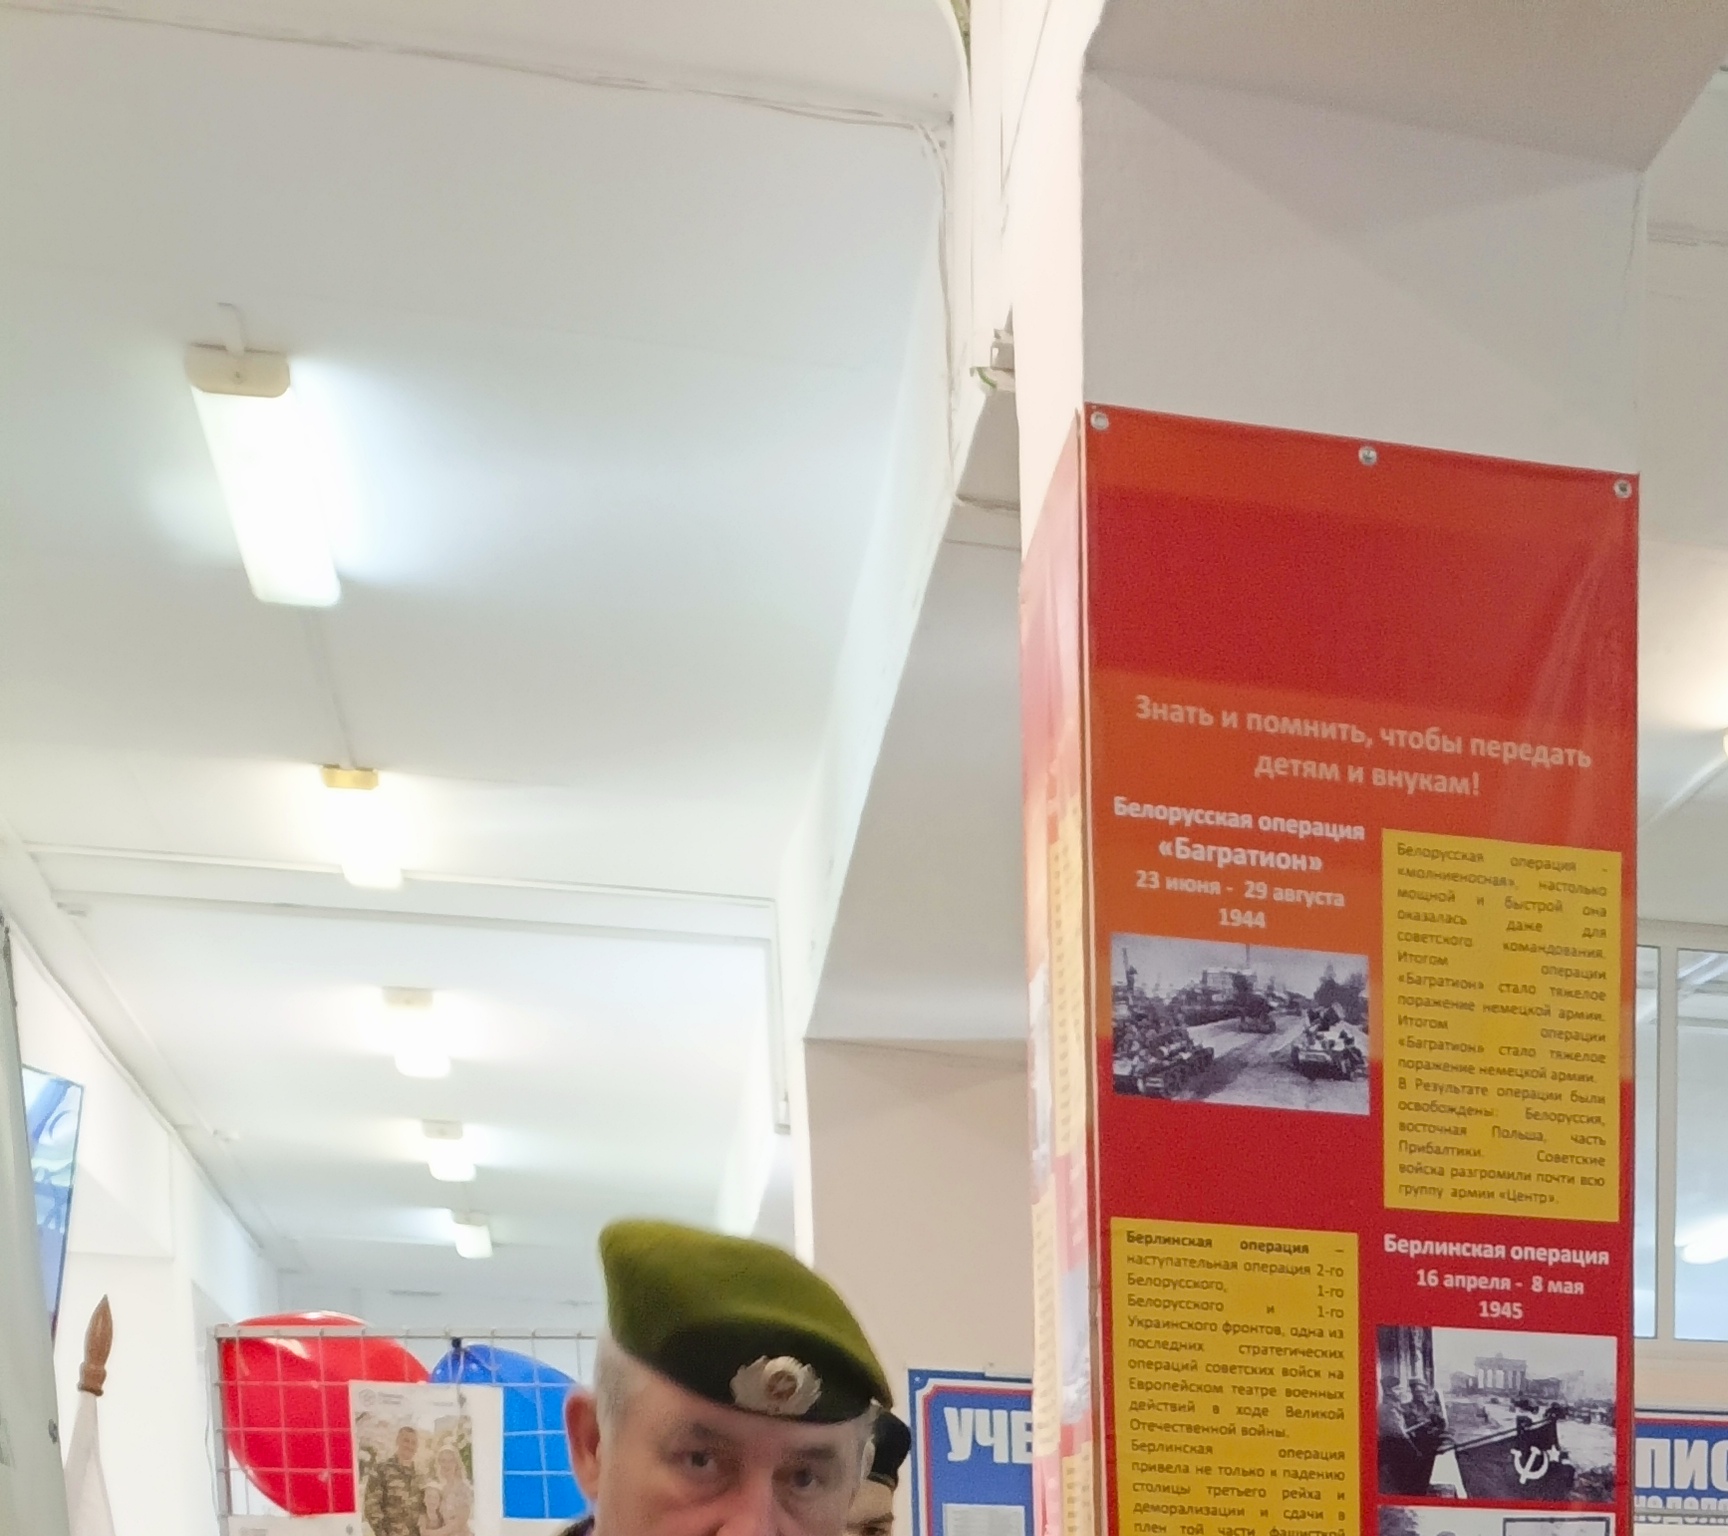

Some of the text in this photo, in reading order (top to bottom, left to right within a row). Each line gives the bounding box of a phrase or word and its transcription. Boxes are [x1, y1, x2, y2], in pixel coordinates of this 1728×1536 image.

[1134, 694, 1214, 726] Знать
[1246, 712, 1373, 749] помнить,
[1379, 726, 1463, 754] чтобы
[1470, 737, 1592, 768] передать
[1254, 754, 1339, 779] детям
[1371, 767, 1480, 796] внукам!
[1113, 795, 1366, 842] Белорусская операция
[1157, 836, 1323, 872] «Багратион»
[1135, 869, 1345, 908] 23 июня 29 августа
[1218, 907, 1266, 928] 1944
[1125, 1229, 1309, 1255] Берлинская операция
[1383, 1232, 1610, 1268] Берлинская операция
[1126, 1254, 1344, 1277] наступательная операция 2-го
[1317, 1284, 1344, 1298] 1-го
[1416, 1268, 1585, 1295] 16 апреля 8 мая
[1127, 1293, 1344, 1318] Белорусского 1-го
[1478, 1300, 1524, 1319] 1945
[1127, 1314, 1218, 1332] Украинского
[1289, 1326, 1324, 1338] одна
[1328, 1328, 1344, 1339] из
[1128, 1337, 1344, 1359] последних стратегических
[1127, 1358, 1344, 1380] операций советских войск на
[1128, 1376, 1344, 1399] Европейском театре военных
[1128, 1398, 1344, 1420] действий ходе Великой
[1129, 1417, 1236, 1435] Отечественной
[1130, 1438, 1345, 1461] Берлинская операция
[1131, 1461, 1345, 1481] привела не только падению
[1132, 1482, 1321, 1500] столицы третьего рейха
[1132, 1502, 1323, 1520] деморализации сдачи
[1133, 1522, 1166, 1533] плен
[1179, 1523, 1204, 1535] той
[1217, 1526, 1255, 1536] части
